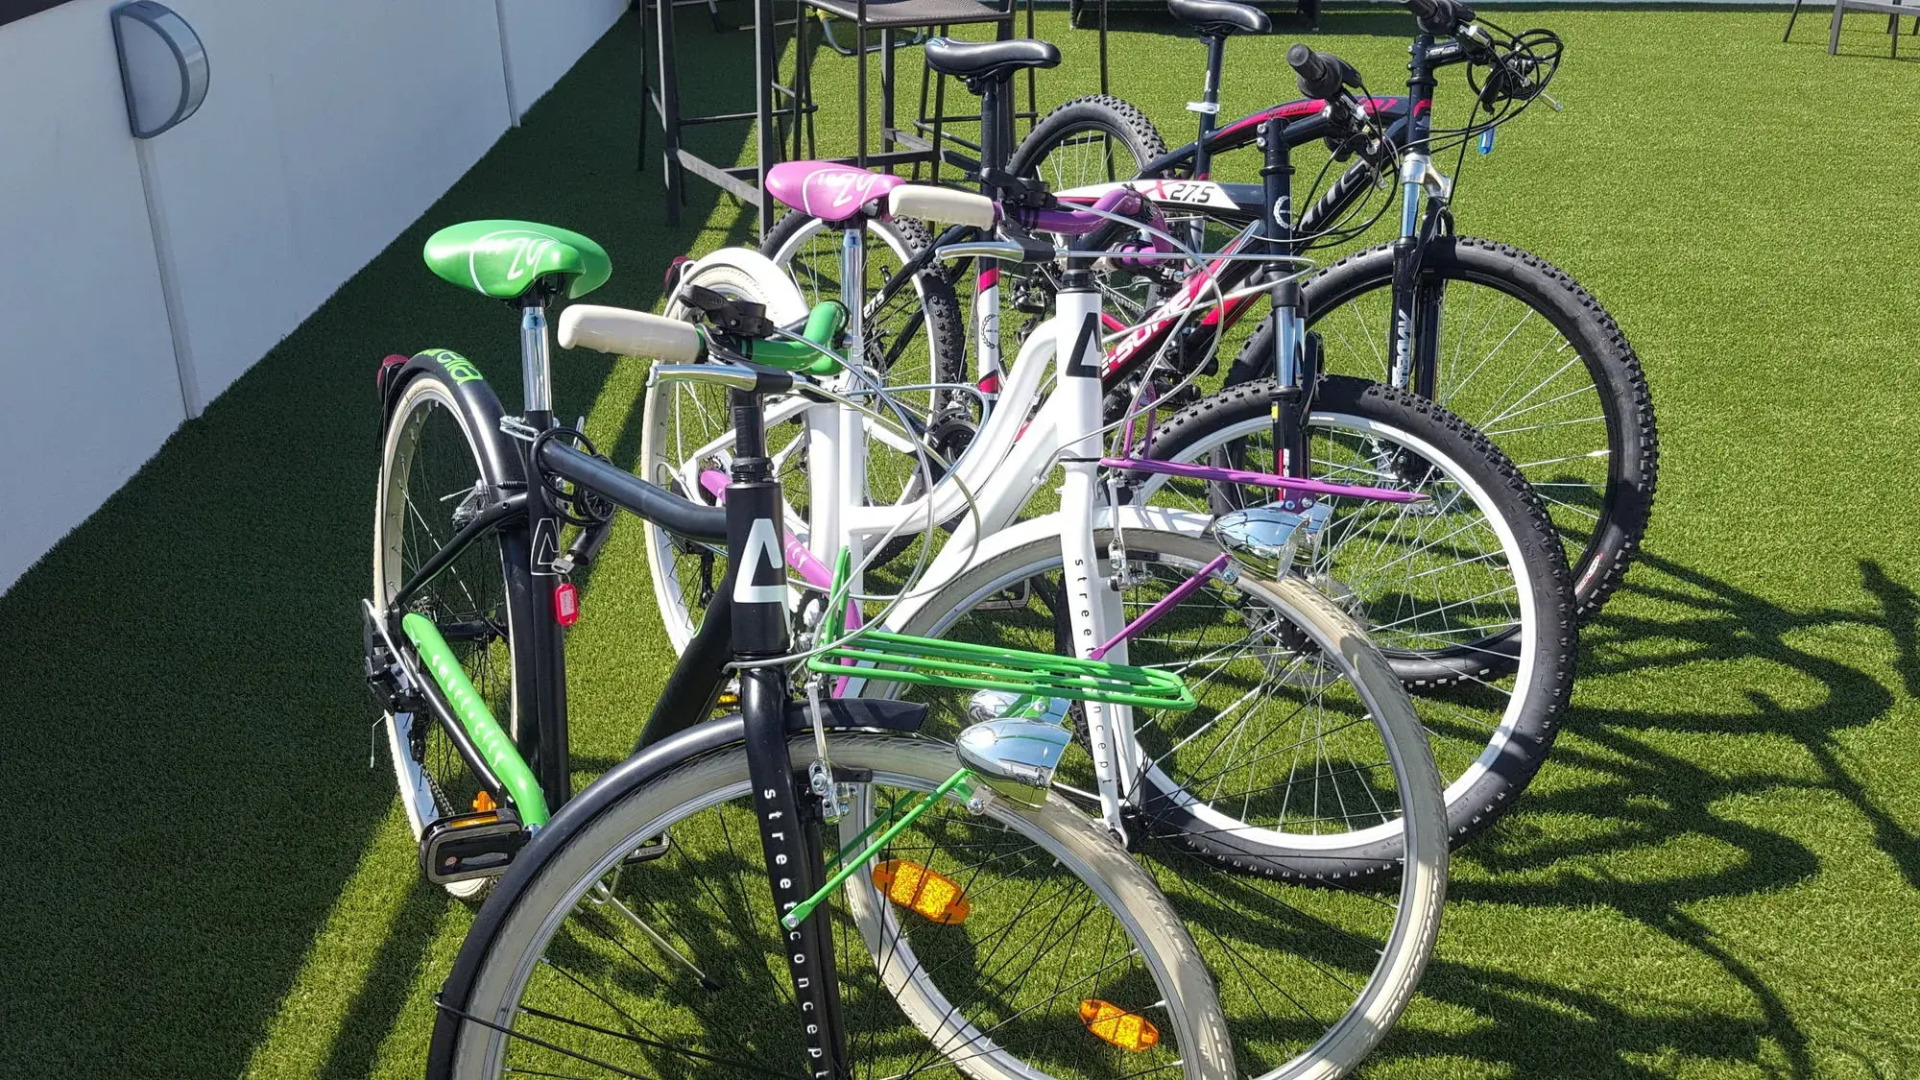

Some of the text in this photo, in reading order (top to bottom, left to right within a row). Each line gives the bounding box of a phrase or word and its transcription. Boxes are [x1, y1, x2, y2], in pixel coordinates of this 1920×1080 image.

[1168, 183, 1215, 204] 27.5
[1075, 559, 1112, 784] street ncept
[764, 788, 830, 1079] street concept
